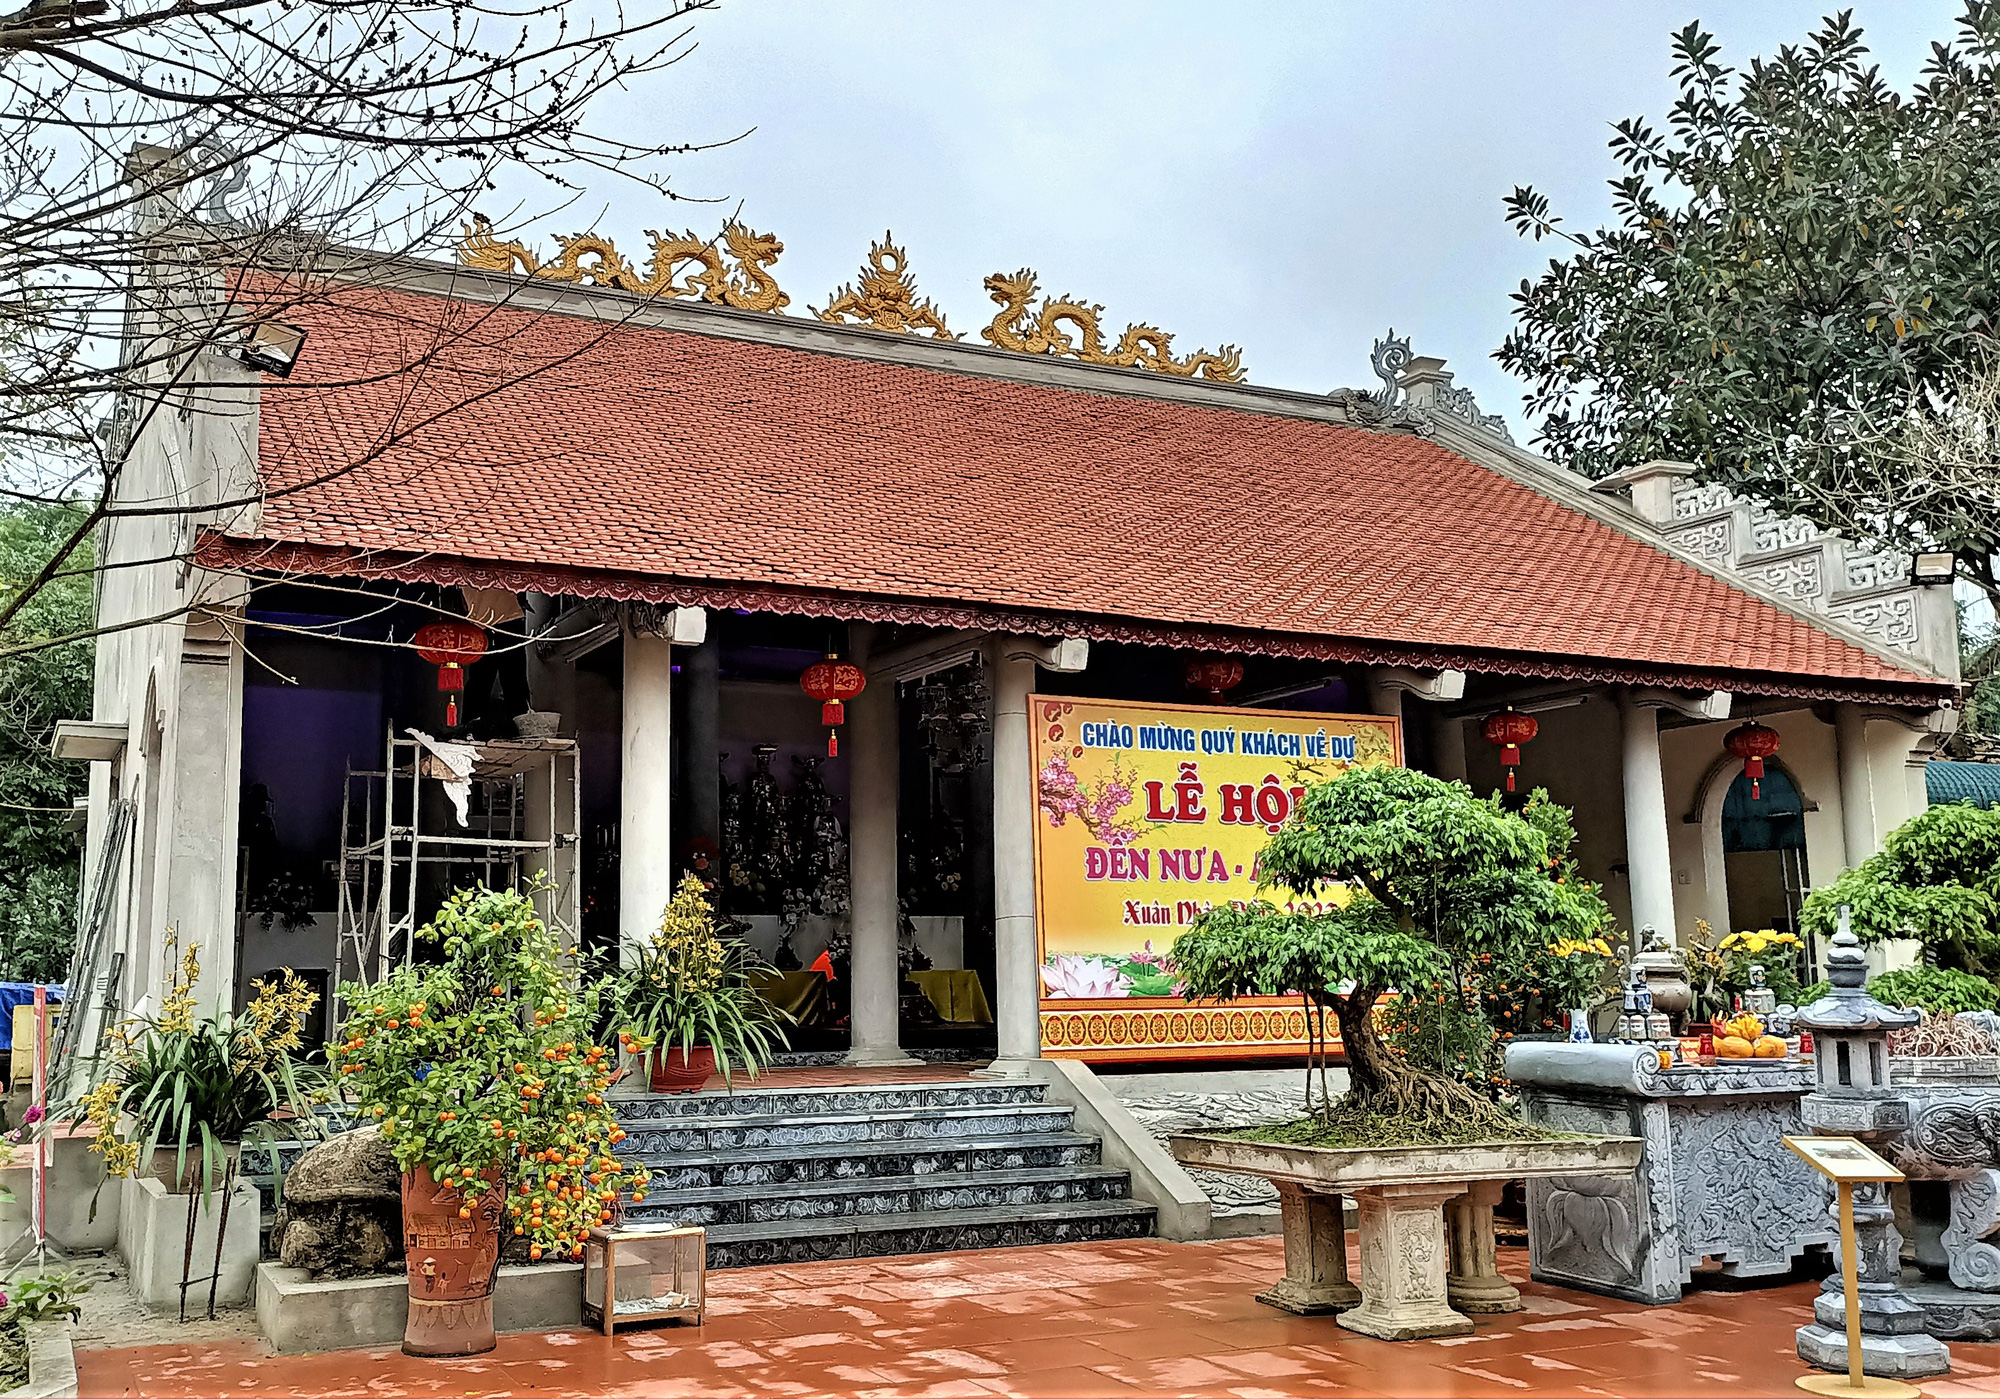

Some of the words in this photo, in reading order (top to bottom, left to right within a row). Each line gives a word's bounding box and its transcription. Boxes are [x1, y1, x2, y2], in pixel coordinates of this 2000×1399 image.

[1083, 720, 1133, 749] CHÀO
[1140, 722, 1195, 751] MỪNG
[1201, 727, 1235, 754] QUÝ
[1241, 729, 1300, 756] KHÁCH
[1305, 729, 1327, 757] VỀ
[1331, 736, 1355, 764] DỰ
[1144, 763, 1207, 822] LỄ
[1086, 831, 1151, 880] ĐỀN
[1159, 847, 1229, 881] NƯA
[1124, 900, 1171, 925] Xuân
